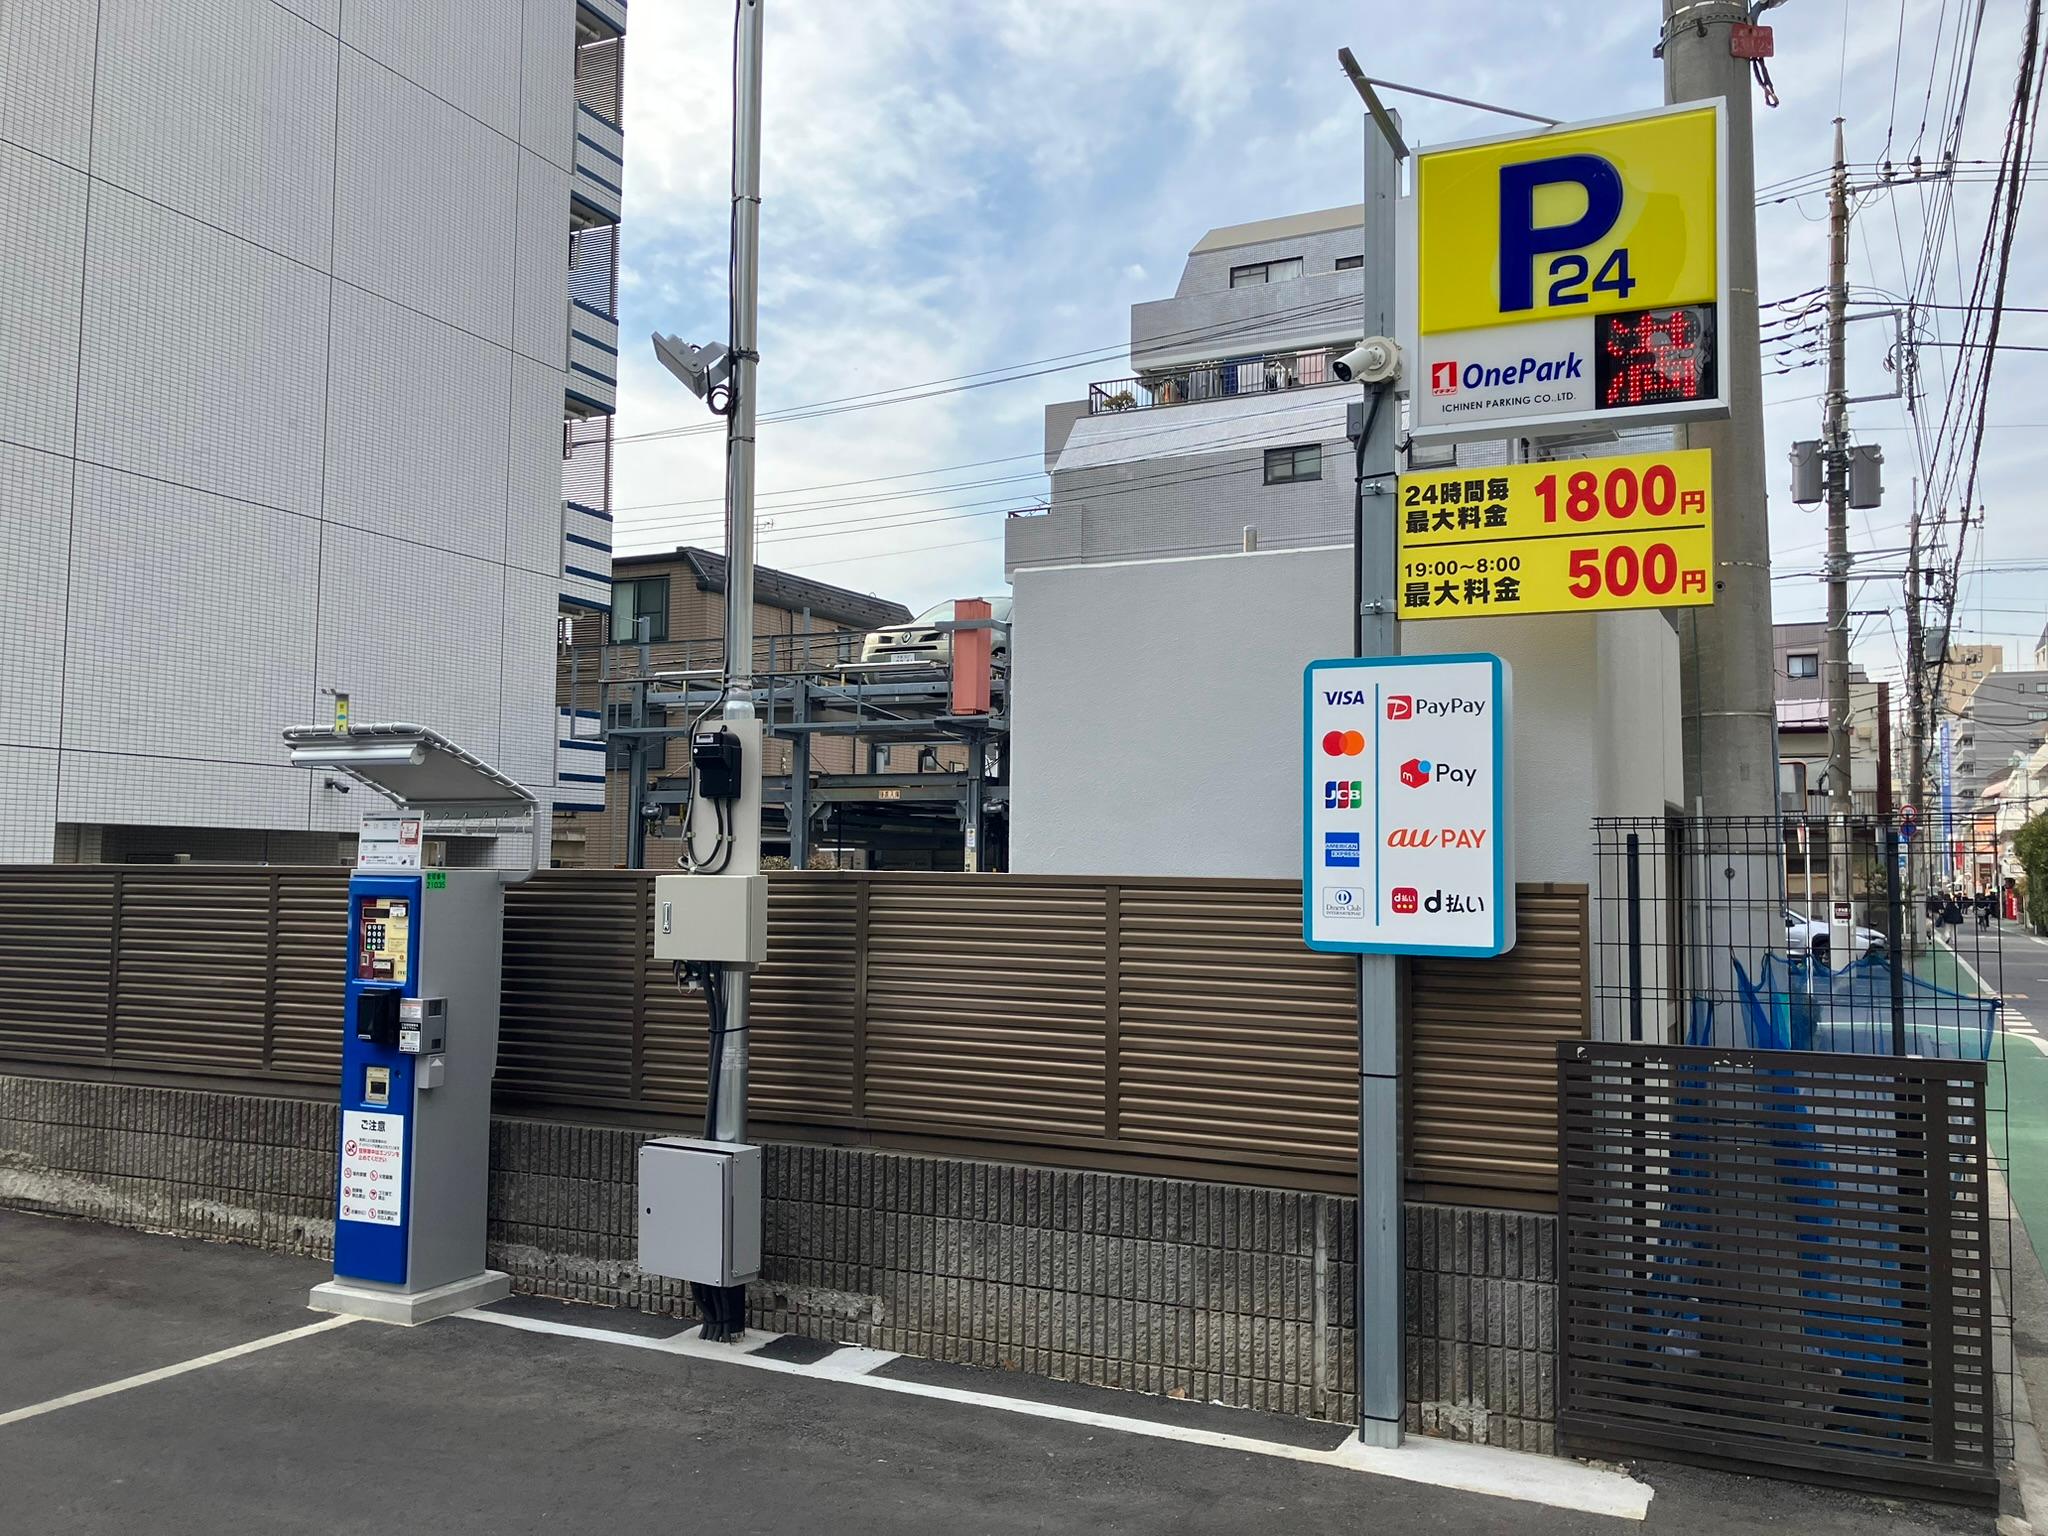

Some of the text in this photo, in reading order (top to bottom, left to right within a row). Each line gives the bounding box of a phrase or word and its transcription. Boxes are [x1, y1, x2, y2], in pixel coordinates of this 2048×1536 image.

[1499, 153, 1624, 314] P
[1548, 248, 1636, 307] 24
[1462, 351, 1584, 389] OnePark
[1442, 400, 1483, 413] ICHINEN
[1485, 396, 1531, 409] PARKING
[1404, 477, 1510, 507] 24時間毎
[1534, 463, 1706, 524] 1800円
[1405, 504, 1509, 535] 最大料金
[1567, 542, 1707, 600] 500円
[1404, 576, 1522, 608] 最大料金
[1323, 690, 1365, 705] VISA
[1416, 698, 1486, 718] PayPay
[1436, 763, 1478, 787] Pay
[1387, 828, 1487, 849] au PAY
[361, 1119, 386, 1132] ご注意
